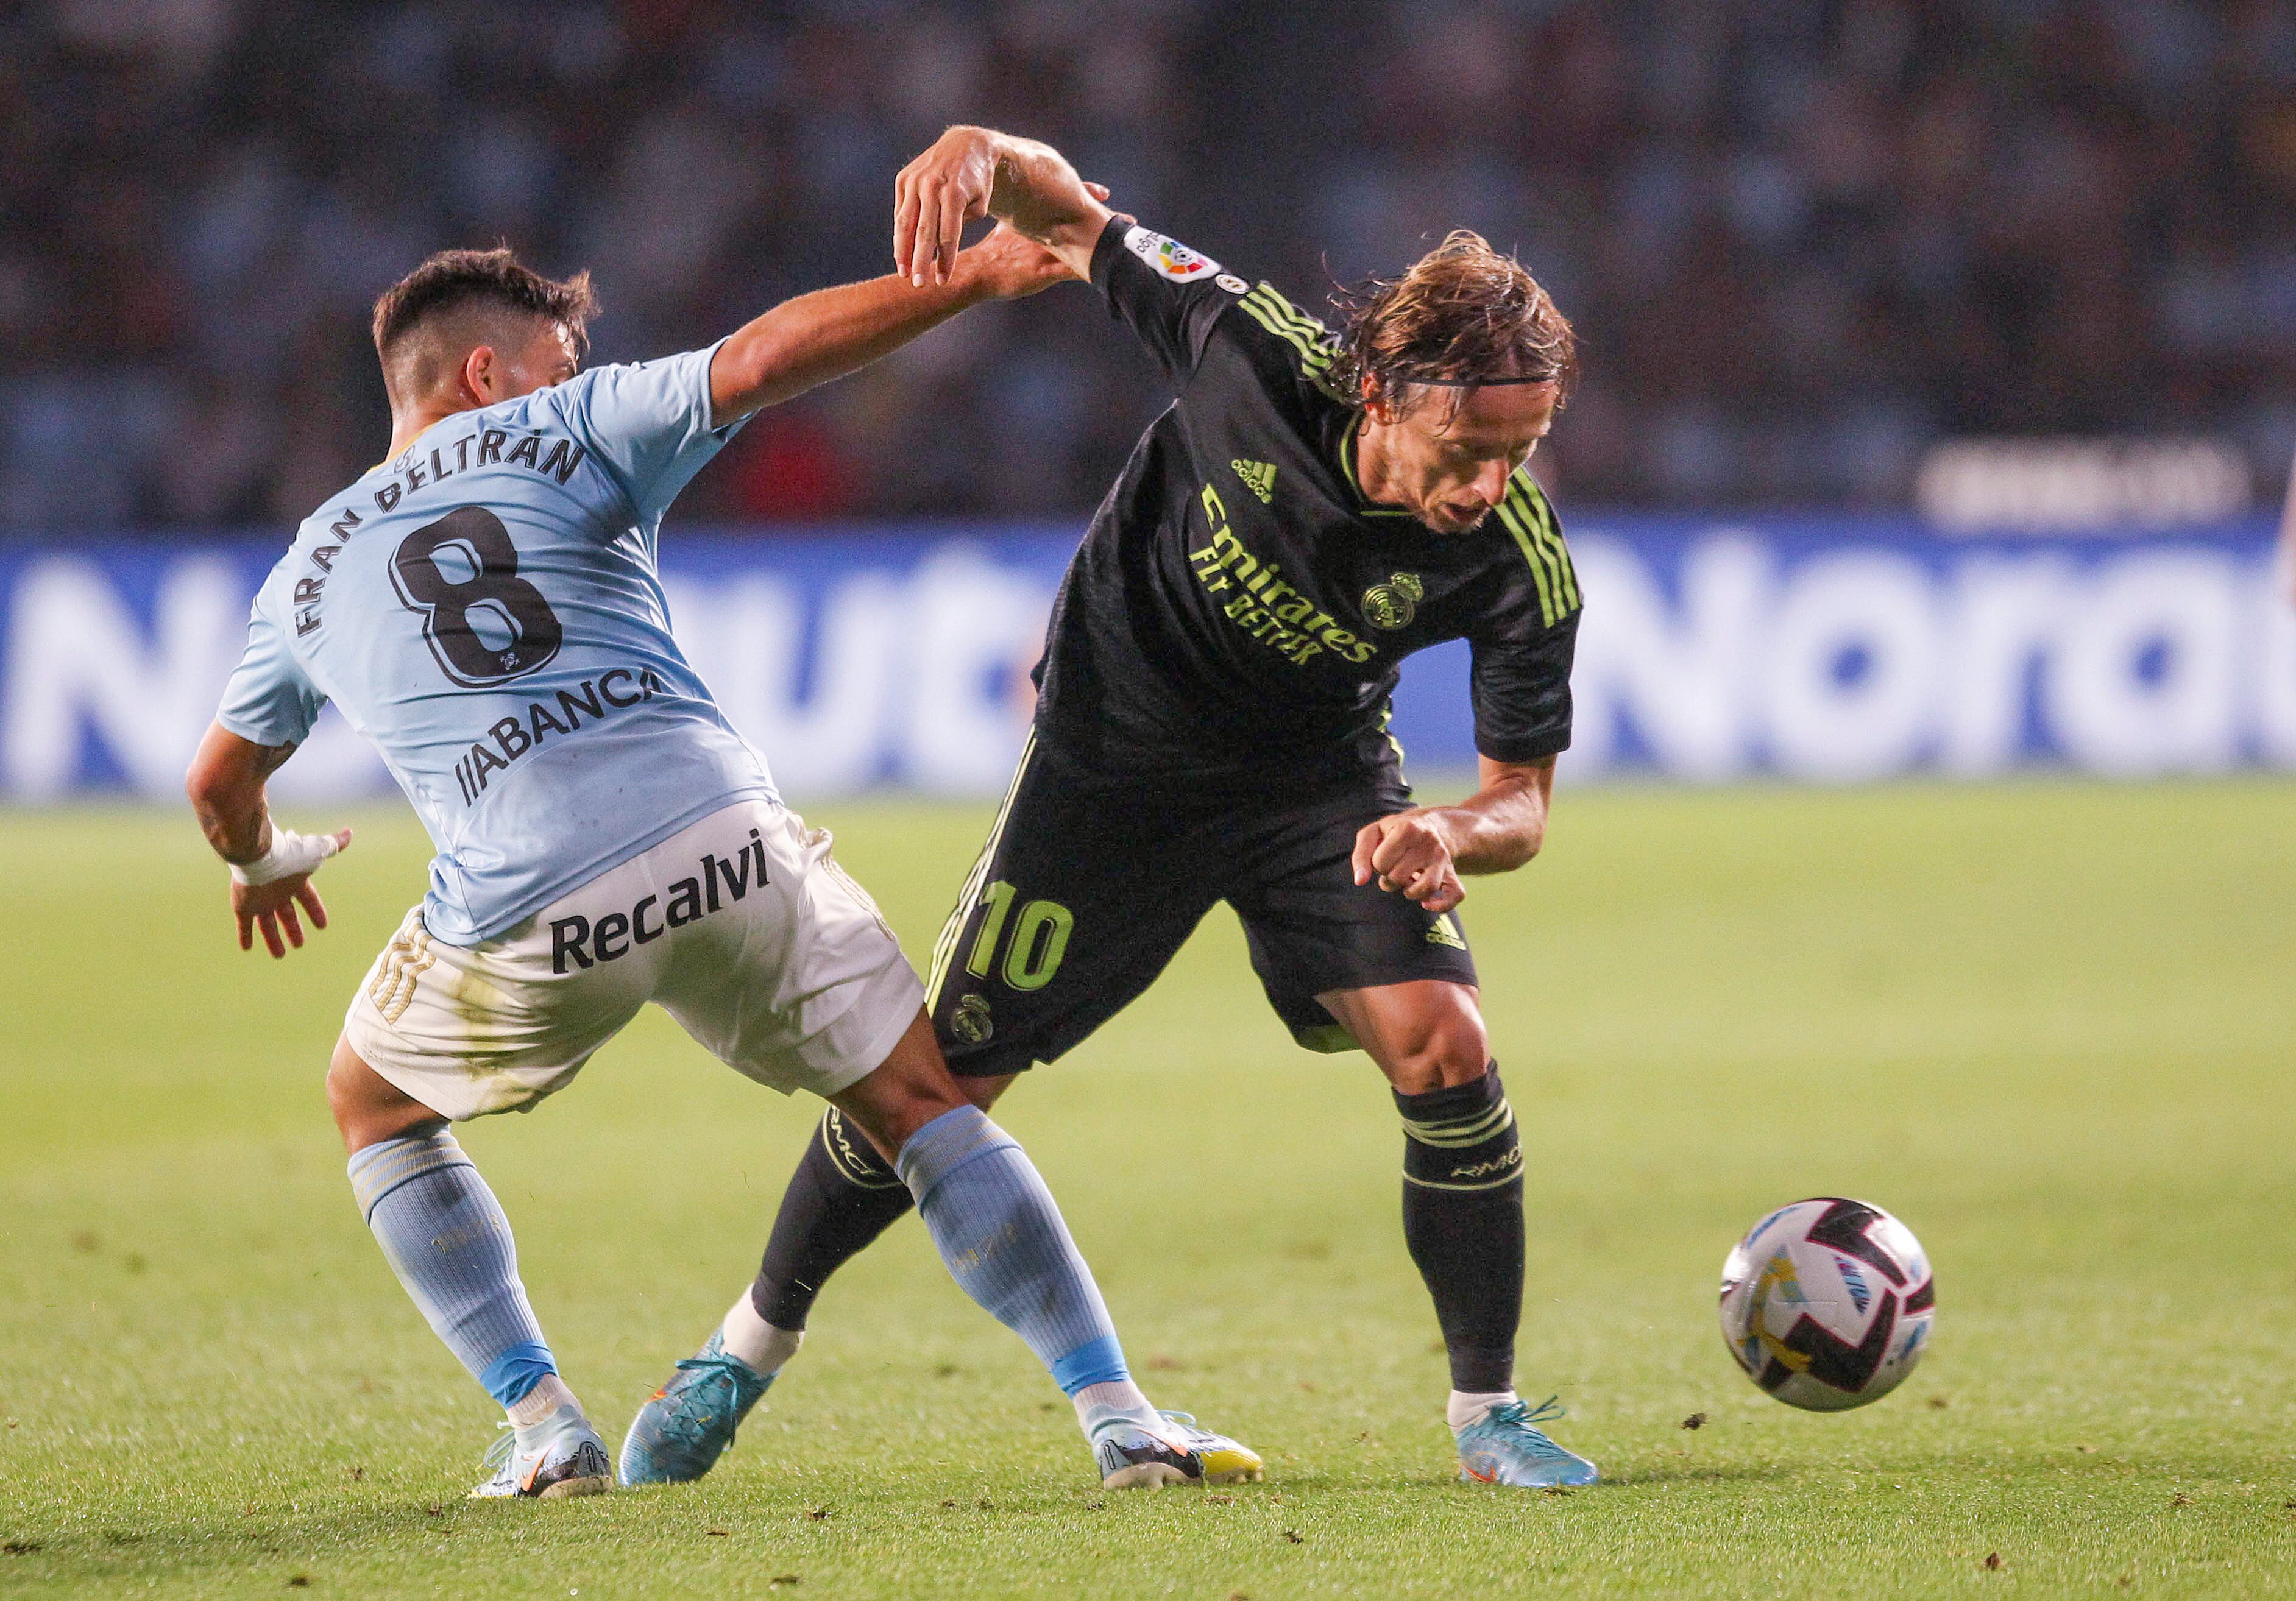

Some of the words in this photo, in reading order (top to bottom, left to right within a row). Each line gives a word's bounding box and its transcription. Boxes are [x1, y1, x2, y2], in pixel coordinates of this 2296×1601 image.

[294, 508, 363, 639] FRAN
[374, 428, 585, 514] BELTRÁN
[1231, 459, 1273, 504] adidas
[388, 506, 562, 690] 8
[1189, 546, 1234, 593] FLY
[1224, 593, 1324, 666] BETTER
[1201, 484, 1378, 663] Emirates
[1557, 531, 2296, 777] Nora
[549, 829, 770, 975] Recalvi
[966, 880, 1074, 992] 10
